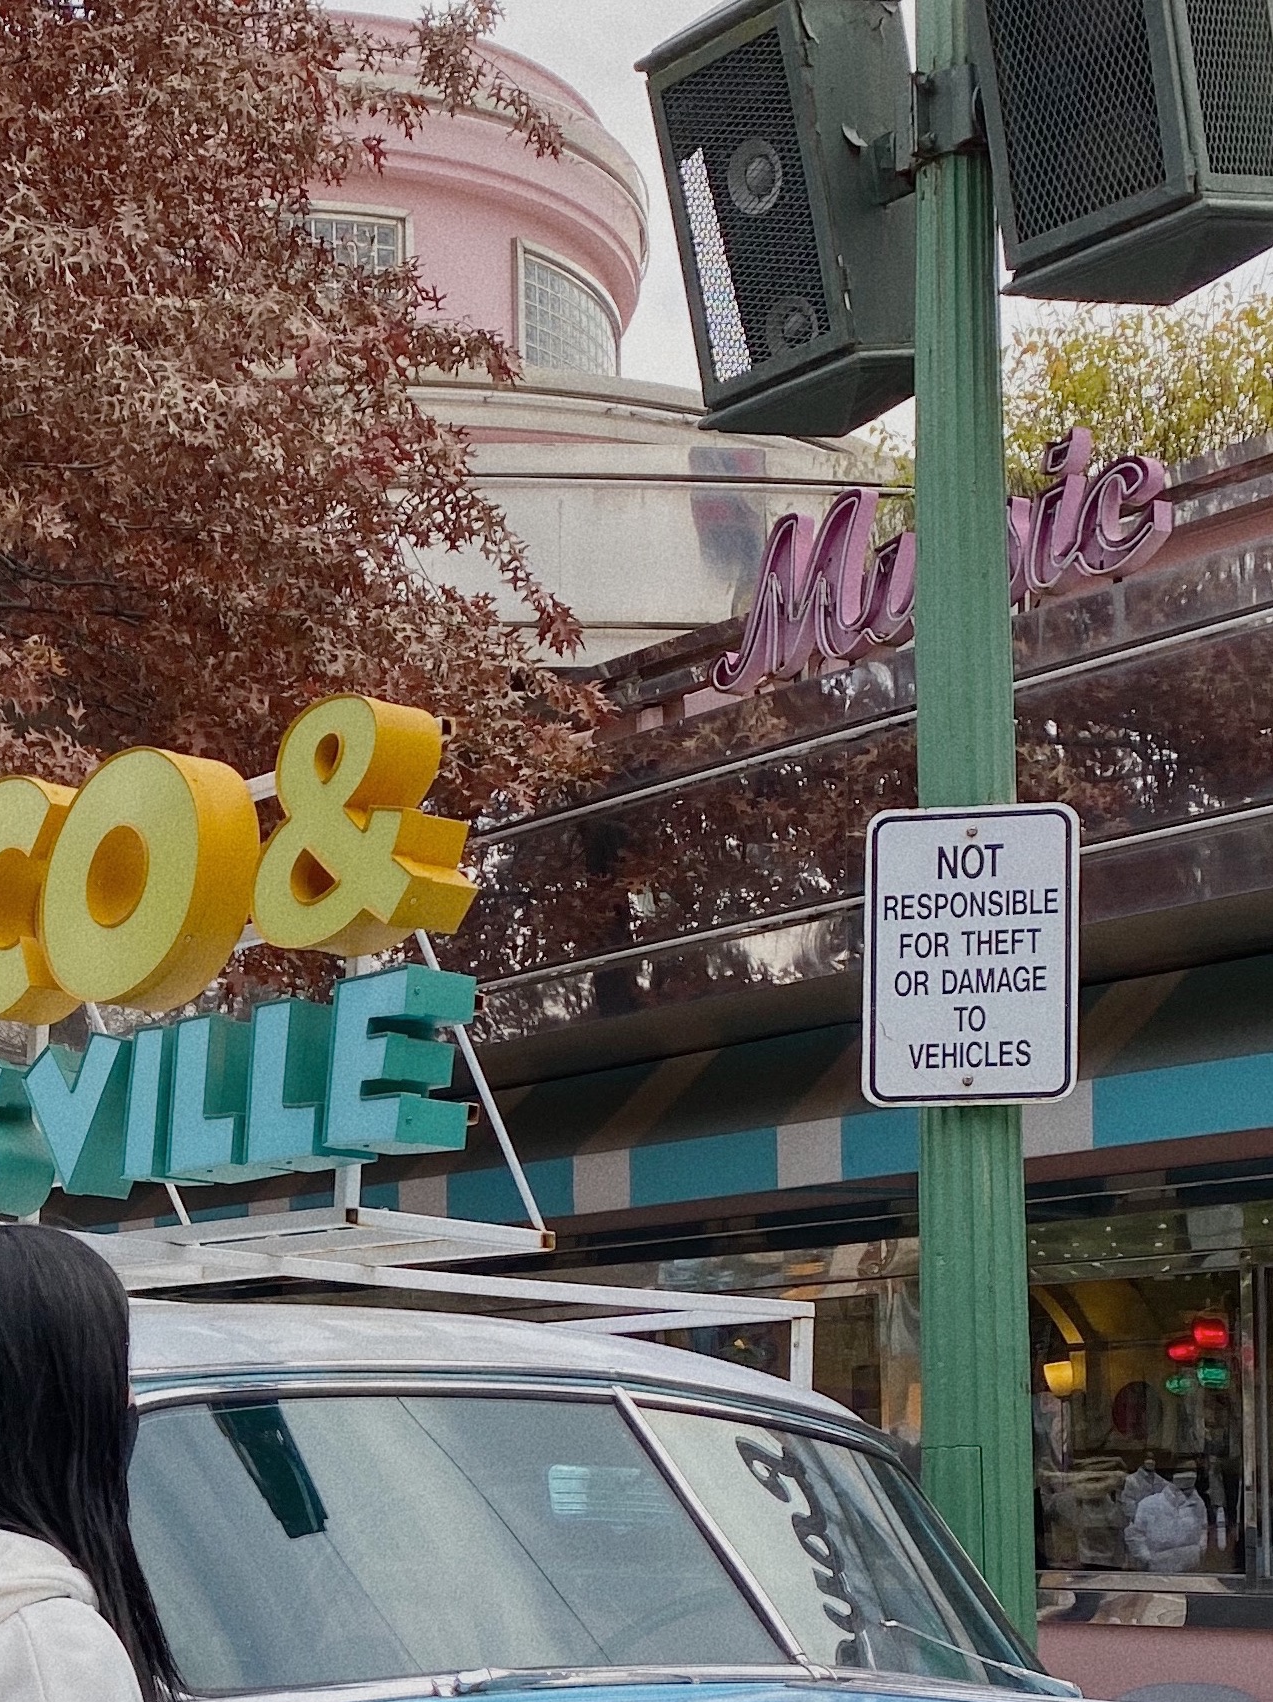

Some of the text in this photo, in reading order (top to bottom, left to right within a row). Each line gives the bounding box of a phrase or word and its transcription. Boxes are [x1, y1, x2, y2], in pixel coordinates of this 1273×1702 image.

[709, 427, 1173, 693] Muic
[251, 693, 480, 957] &
[937, 843, 1004, 879] NOT
[883, 888, 1059, 920] RESPONSIBLE
[899, 928, 1042, 958] FOR THEFT
[894, 966, 1047, 997] OR DAMAGE
[954, 1005, 986, 1032] TO
[909, 1040, 1032, 1070] VEHICLES
